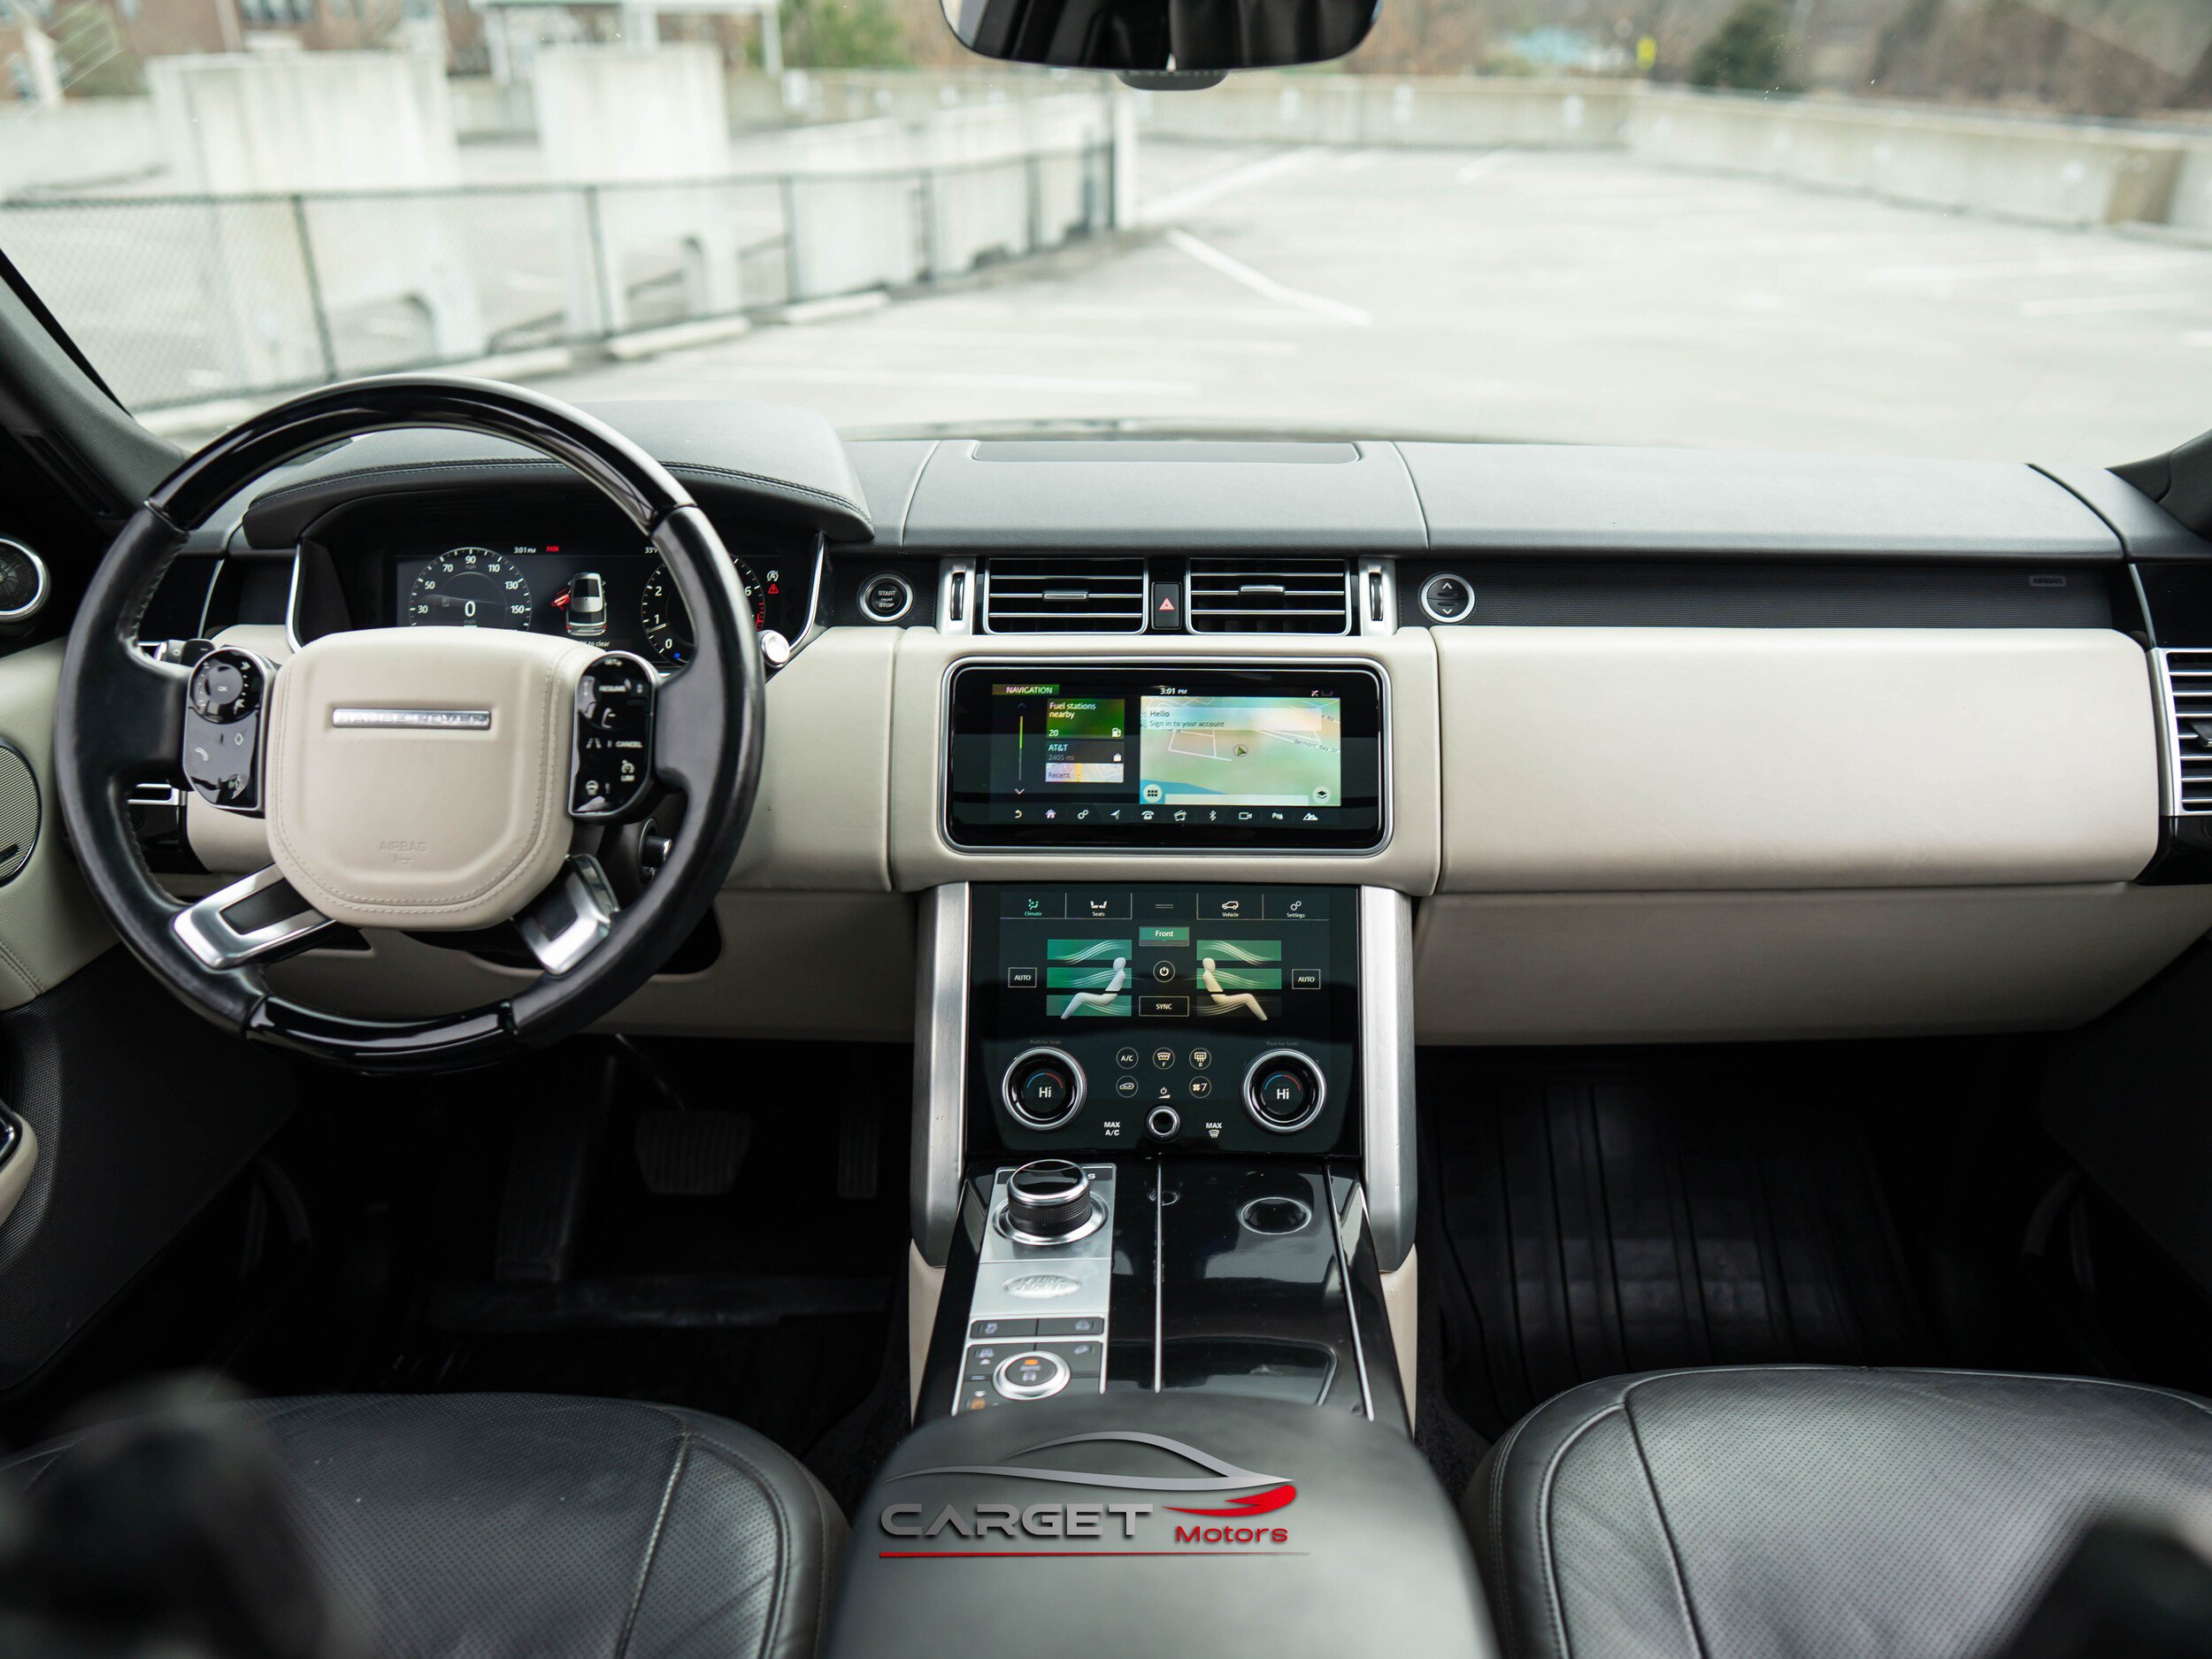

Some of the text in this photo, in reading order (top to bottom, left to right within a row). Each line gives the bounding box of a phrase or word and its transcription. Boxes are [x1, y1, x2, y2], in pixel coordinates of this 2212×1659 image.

[465, 555, 476, 565] 90
[442, 563, 454, 573] 70
[488, 563, 501, 573] 110
[424, 580, 435, 590] 50
[505, 580, 518, 590] 130
[654, 585, 663, 596] 2
[744, 586, 752, 596] 6
[418, 604, 428, 614] 30
[464, 600, 476, 618] 0
[511, 604, 525, 614] 150
[654, 613, 660, 625] 1
[664, 638, 672, 649] 0
[1005, 686, 1053, 695] NAVIGATION
[1066, 702, 1096, 710] stations
[1048, 710, 1075, 720] nearby
[1048, 728, 1059, 737] 20
[1048, 743, 1069, 752] AT&T
[1039, 1087, 1052, 1098] Hi
[1201, 1083, 1208, 1092] 7
[1276, 1087, 1290, 1100] Hi
